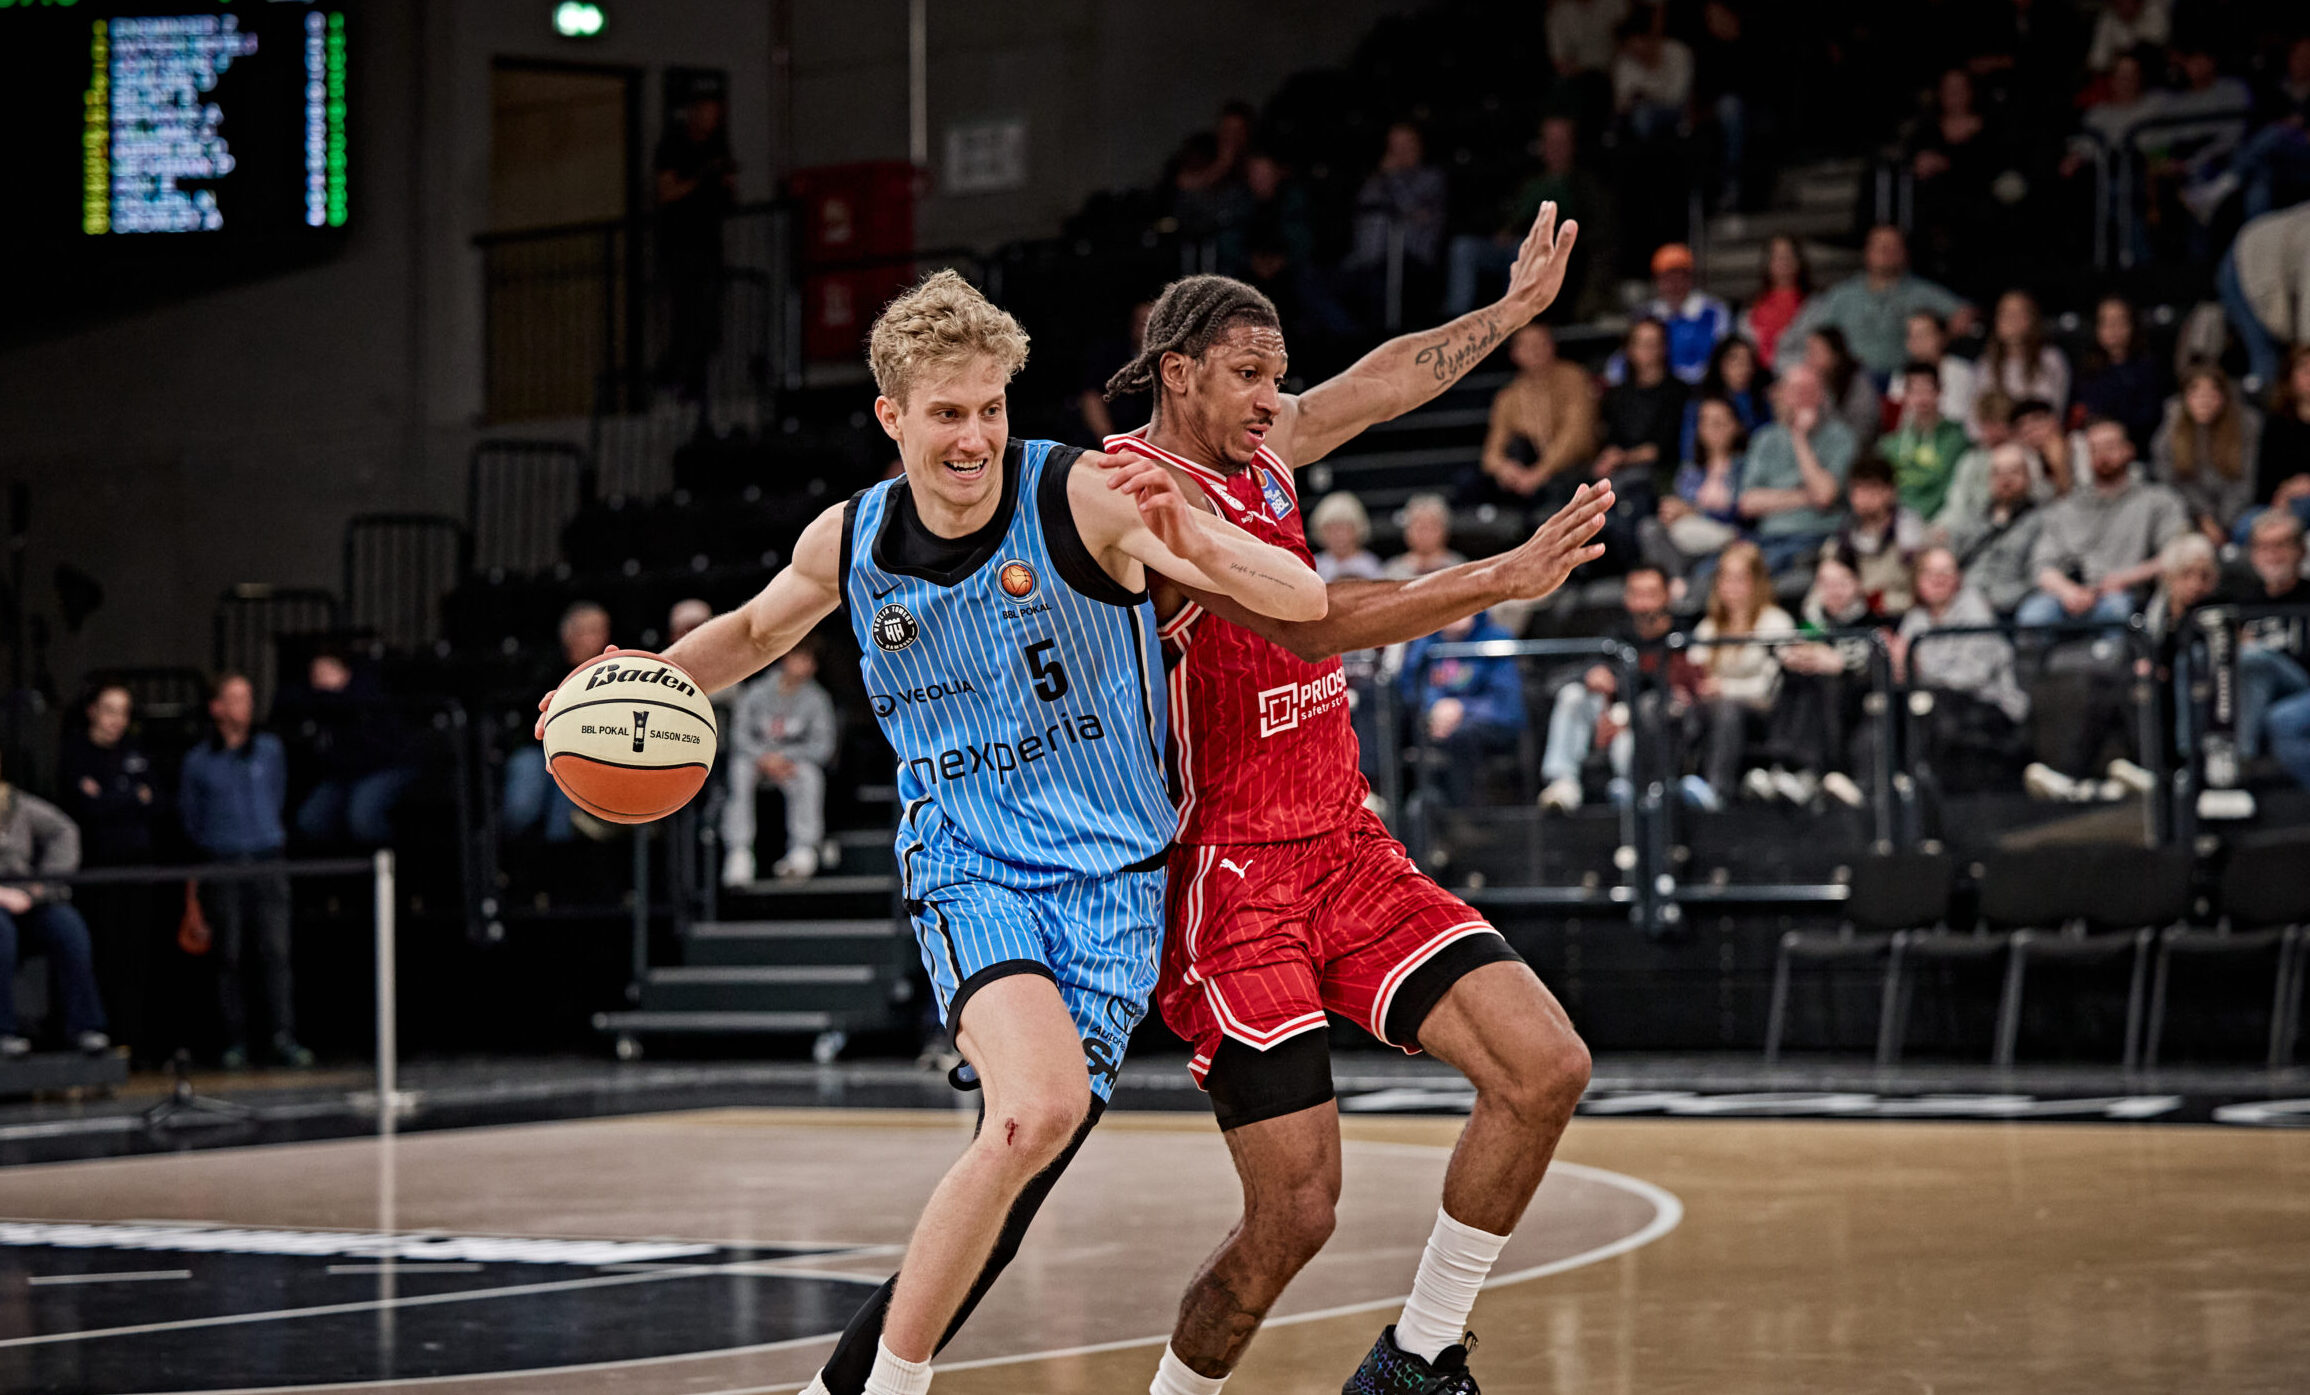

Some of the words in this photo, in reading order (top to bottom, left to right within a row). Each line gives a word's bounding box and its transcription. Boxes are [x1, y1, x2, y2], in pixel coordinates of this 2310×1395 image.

[1002, 610, 1019, 620] BBL
[1020, 604, 1053, 618] POKAL
[1024, 637, 1069, 703] 5
[585, 664, 696, 698] Baden
[897, 680, 977, 705] VEOLIA
[1301, 702, 1330, 720] safety
[581, 725, 597, 734] BBL
[599, 726, 629, 736] POKAL
[649, 729, 681, 742] SAISON
[681, 733, 701, 745] 25/26
[910, 712, 1105, 785] nexperia
